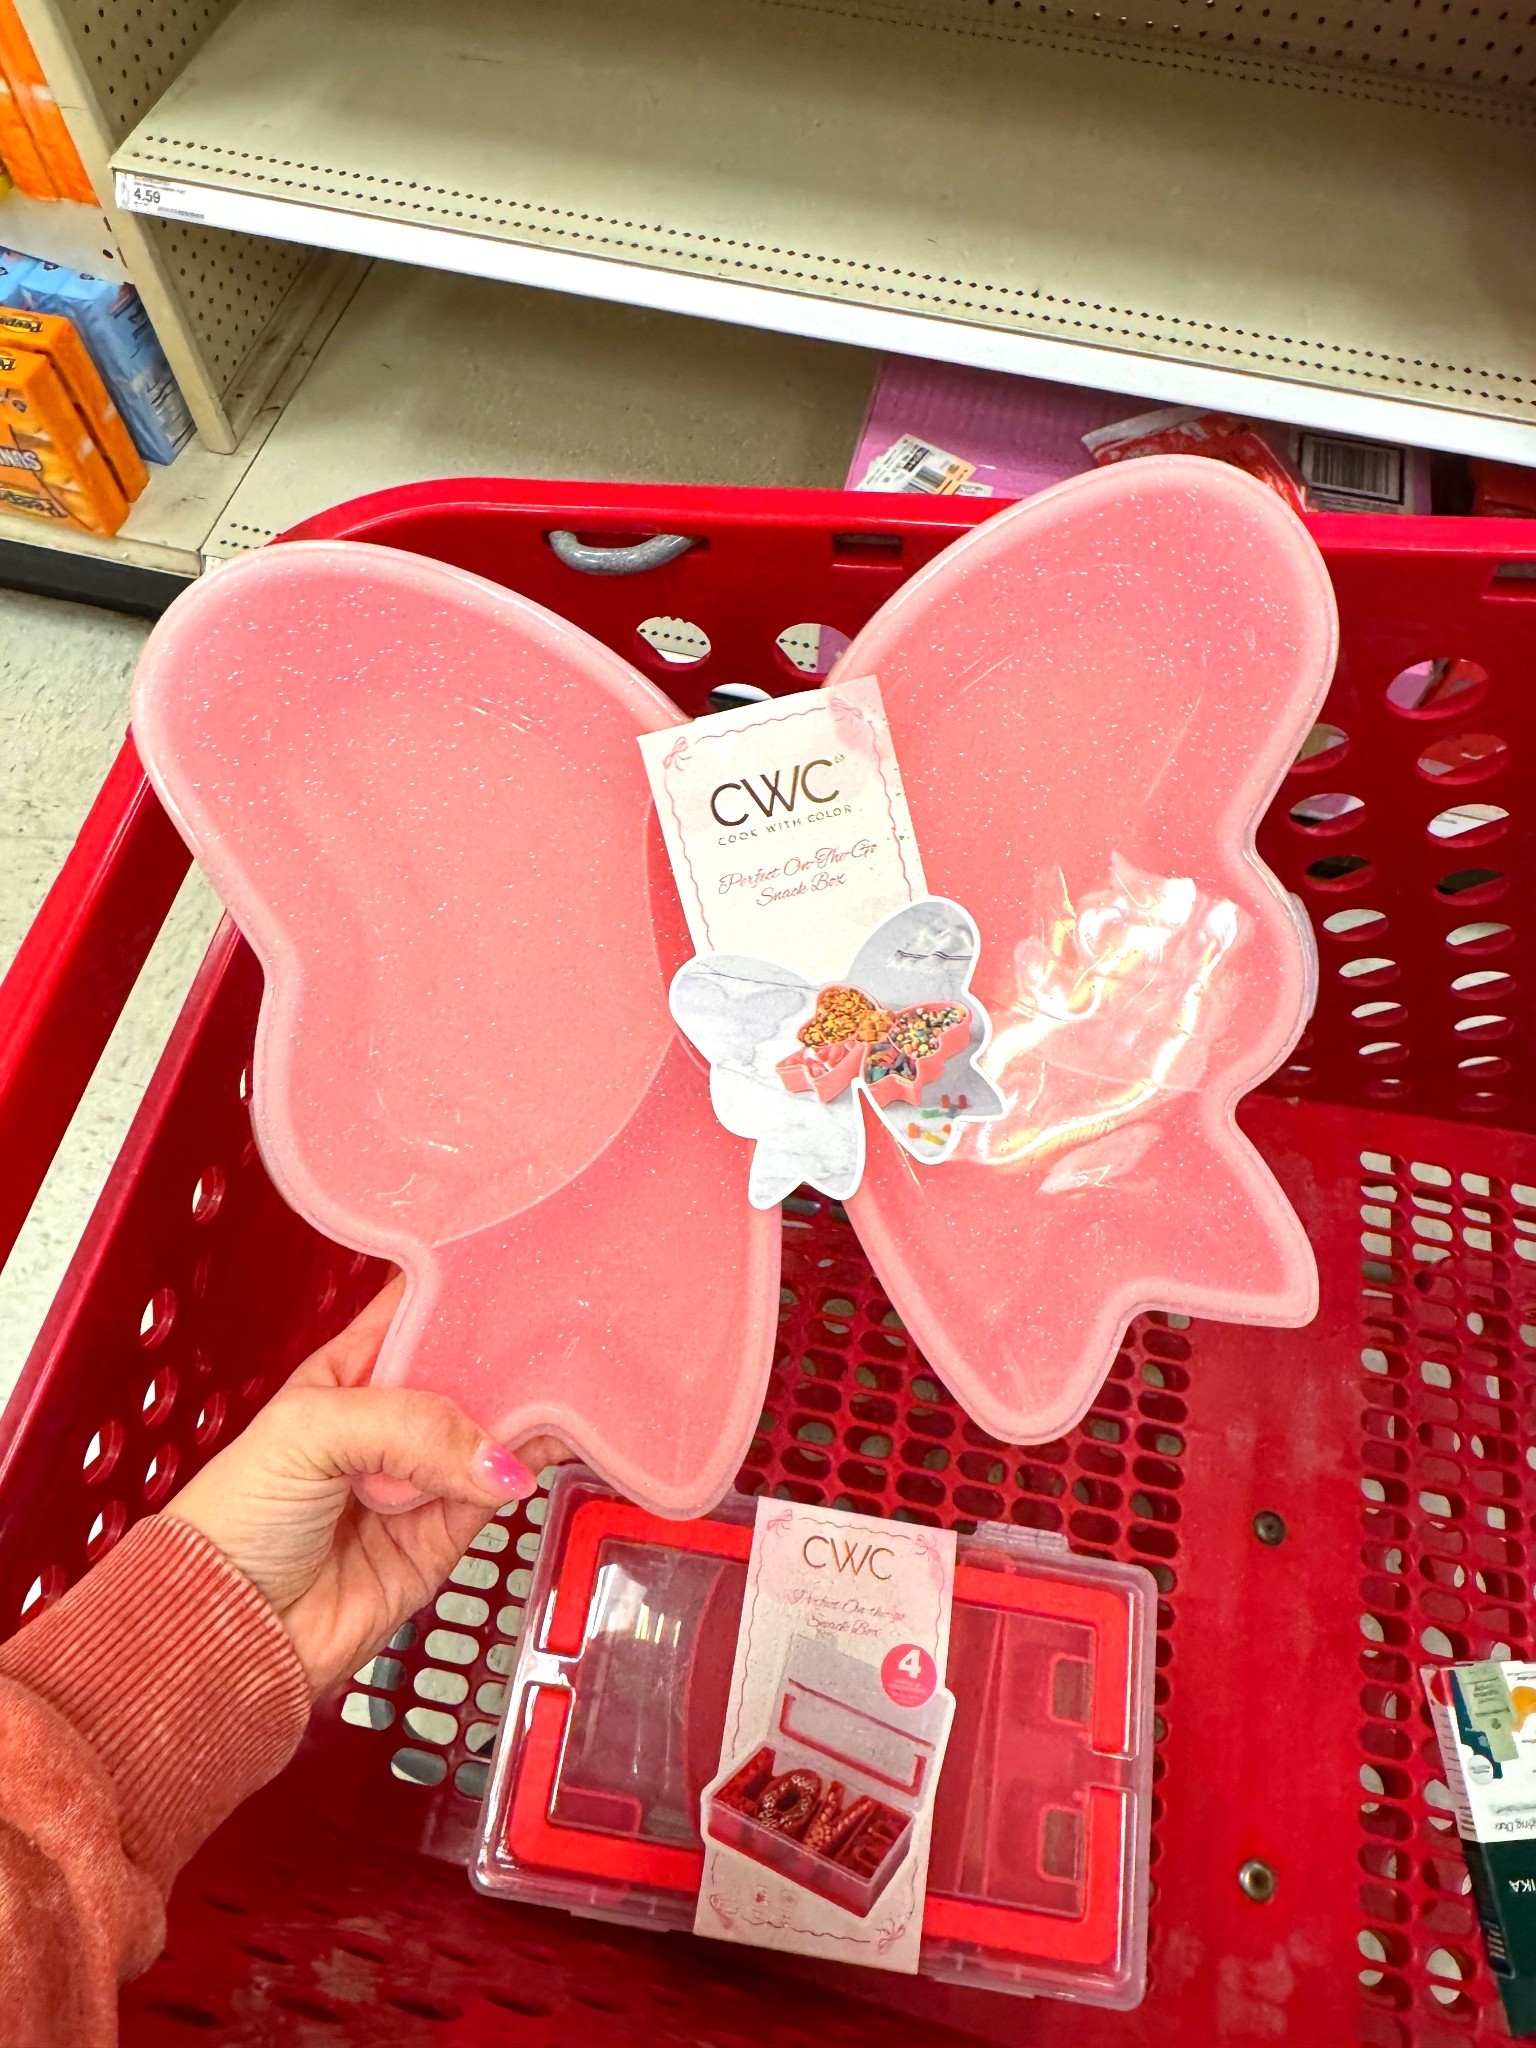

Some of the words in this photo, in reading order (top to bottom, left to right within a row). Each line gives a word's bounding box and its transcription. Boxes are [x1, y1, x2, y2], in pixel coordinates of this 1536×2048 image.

[134, 187, 160, 204] 4.59
[710, 759, 840, 827] CWC
[718, 829, 758, 846] COOK
[766, 817, 802, 833] WITH
[808, 804, 852, 823] COLOR
[718, 867, 780, 895] Perfect
[755, 880, 808, 907] Snack
[810, 871, 847, 891] Box
[803, 1535, 896, 1581] CWC
[897, 1648, 923, 1680] 4
